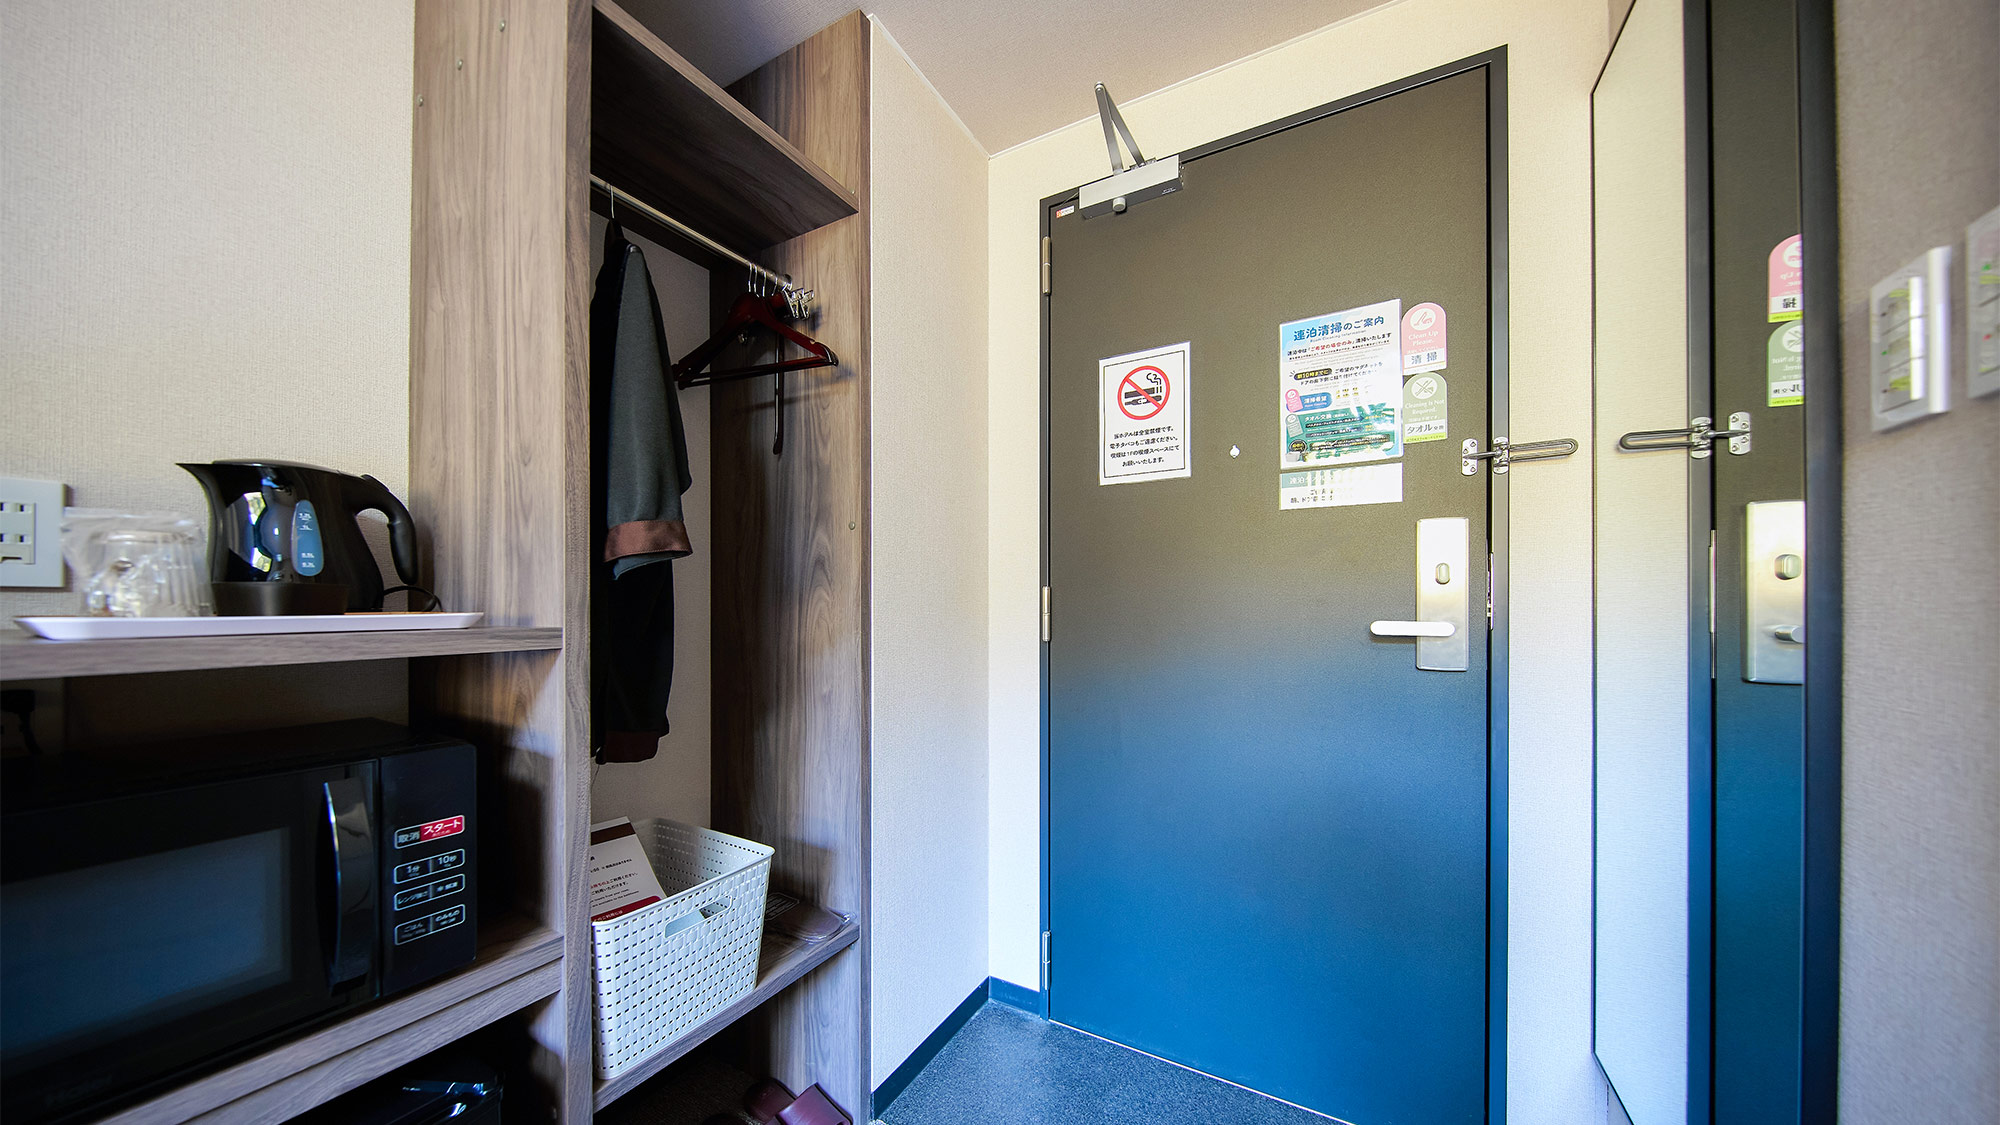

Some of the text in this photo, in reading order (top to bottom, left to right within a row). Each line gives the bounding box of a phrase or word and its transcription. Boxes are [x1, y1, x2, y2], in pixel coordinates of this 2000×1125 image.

[1293, 316, 1385, 342] 連泊清掃のご案内
[1408, 332, 1427, 340] Clean
[1411, 351, 1438, 365] 清掃
[1114, 425, 1174, 440] 当ホテルは全室禁煙です。
[1110, 436, 1178, 449] 電子タバコもご遠慮ください。
[1122, 457, 1164, 467] お願いいたします。
[424, 819, 462, 836] スタート
[398, 831, 420, 843] 取消
